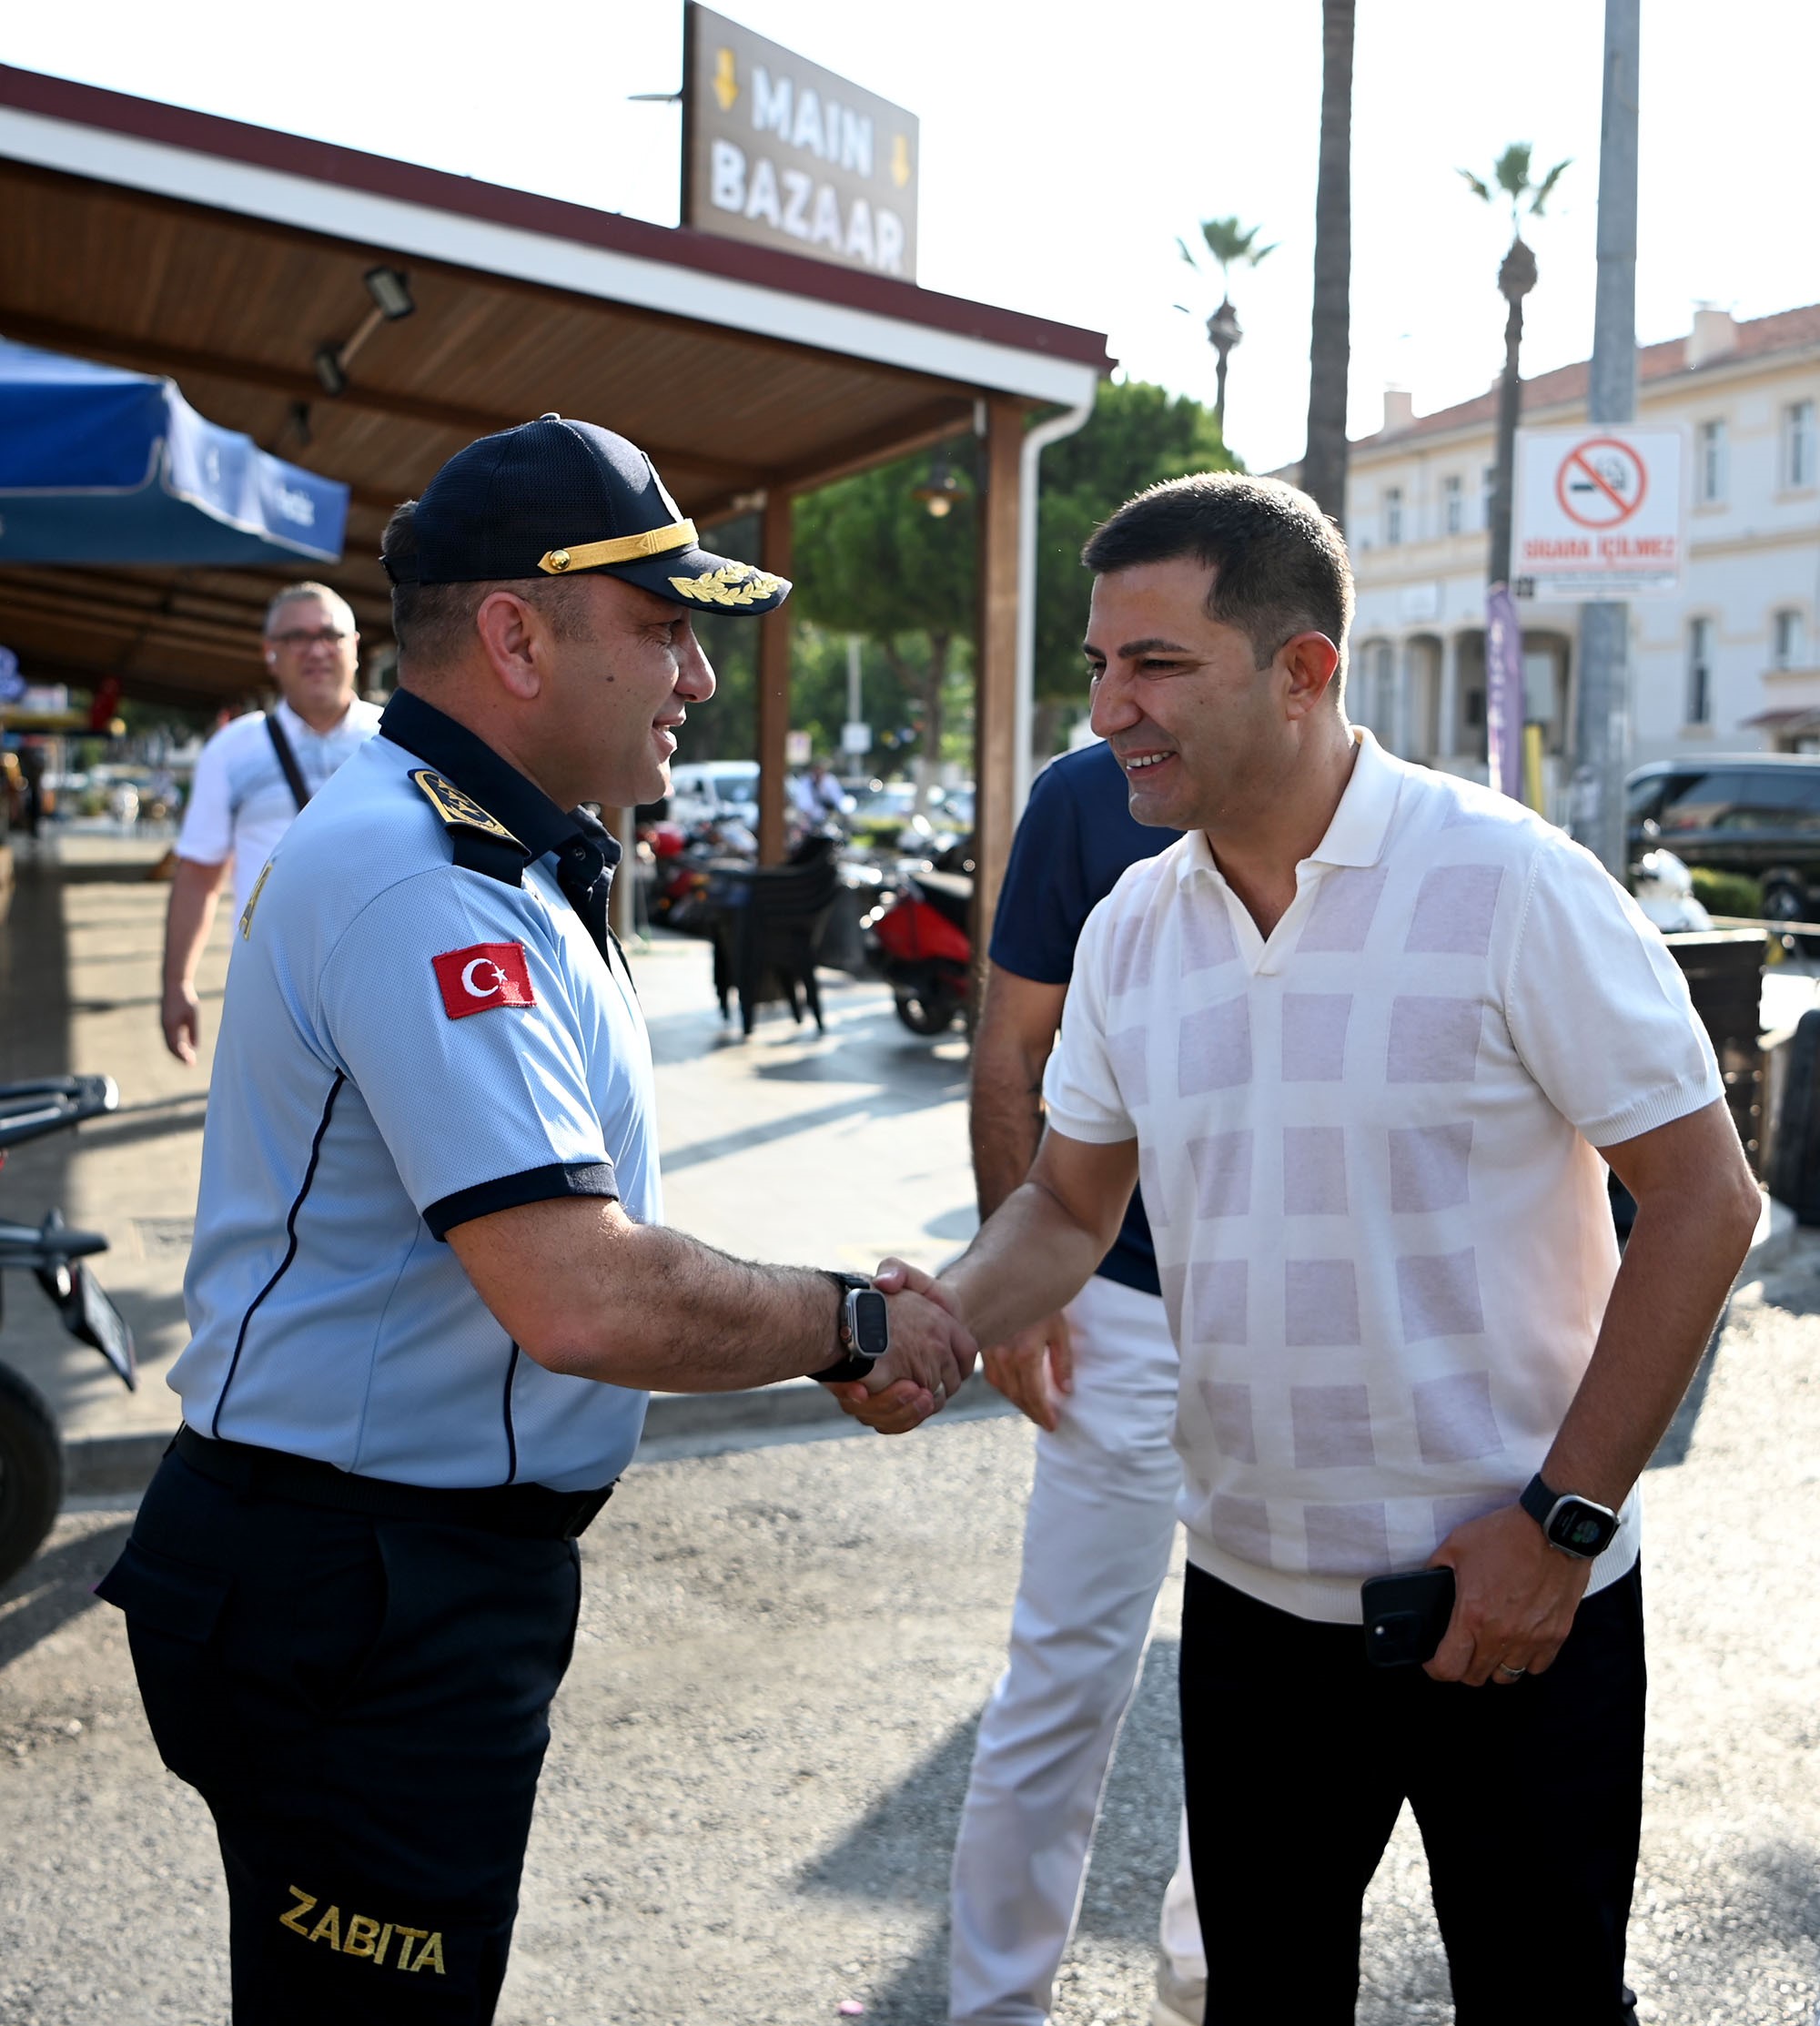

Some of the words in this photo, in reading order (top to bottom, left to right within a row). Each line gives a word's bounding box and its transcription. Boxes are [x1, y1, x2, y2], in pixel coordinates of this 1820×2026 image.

[752, 66, 873, 177] MAIN
[712, 139, 905, 275] BAZAAR
[279, 1885, 446, 1974] ZABITA
